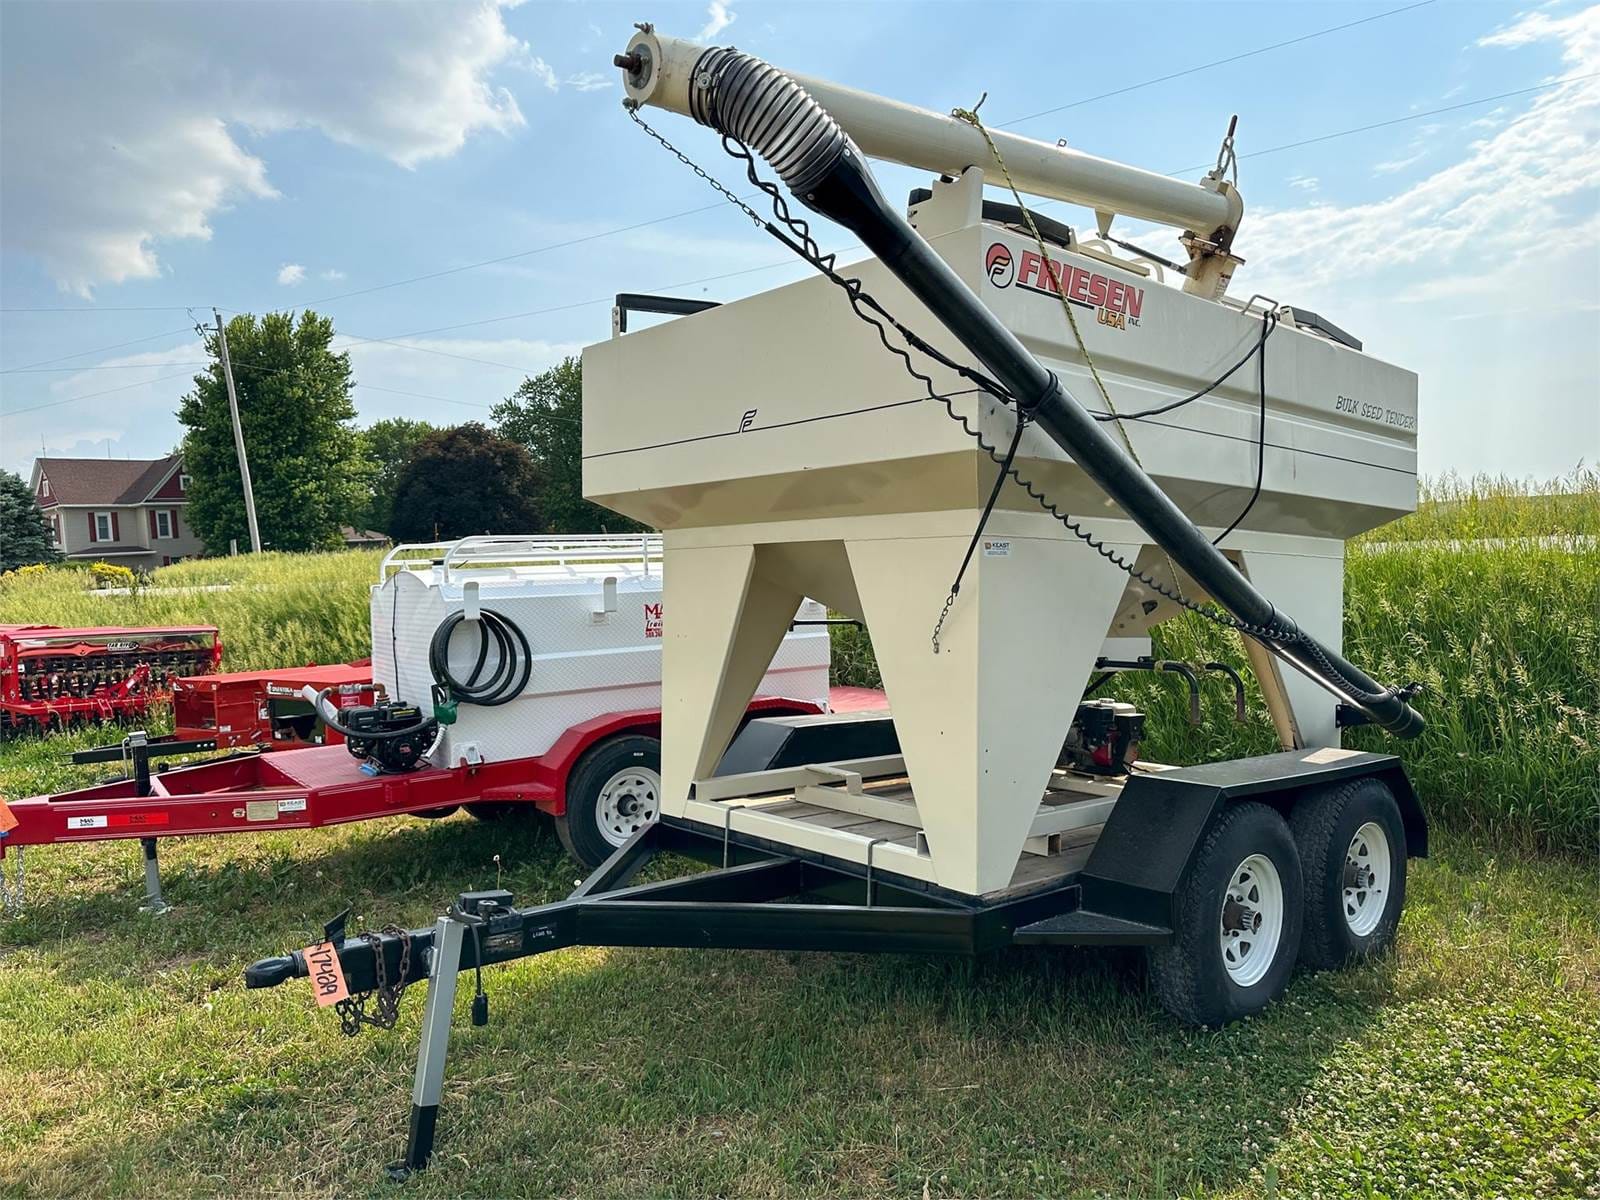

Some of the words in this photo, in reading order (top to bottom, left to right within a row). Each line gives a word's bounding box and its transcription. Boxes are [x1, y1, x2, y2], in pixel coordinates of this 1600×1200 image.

[1017, 250, 1144, 318] FRIESEN
[1097, 308, 1126, 330] USA
[1336, 396, 1360, 415] BULK
[1361, 402, 1383, 420] SEED
[1385, 409, 1416, 429] TENDER
[309, 948, 338, 996] 17429
